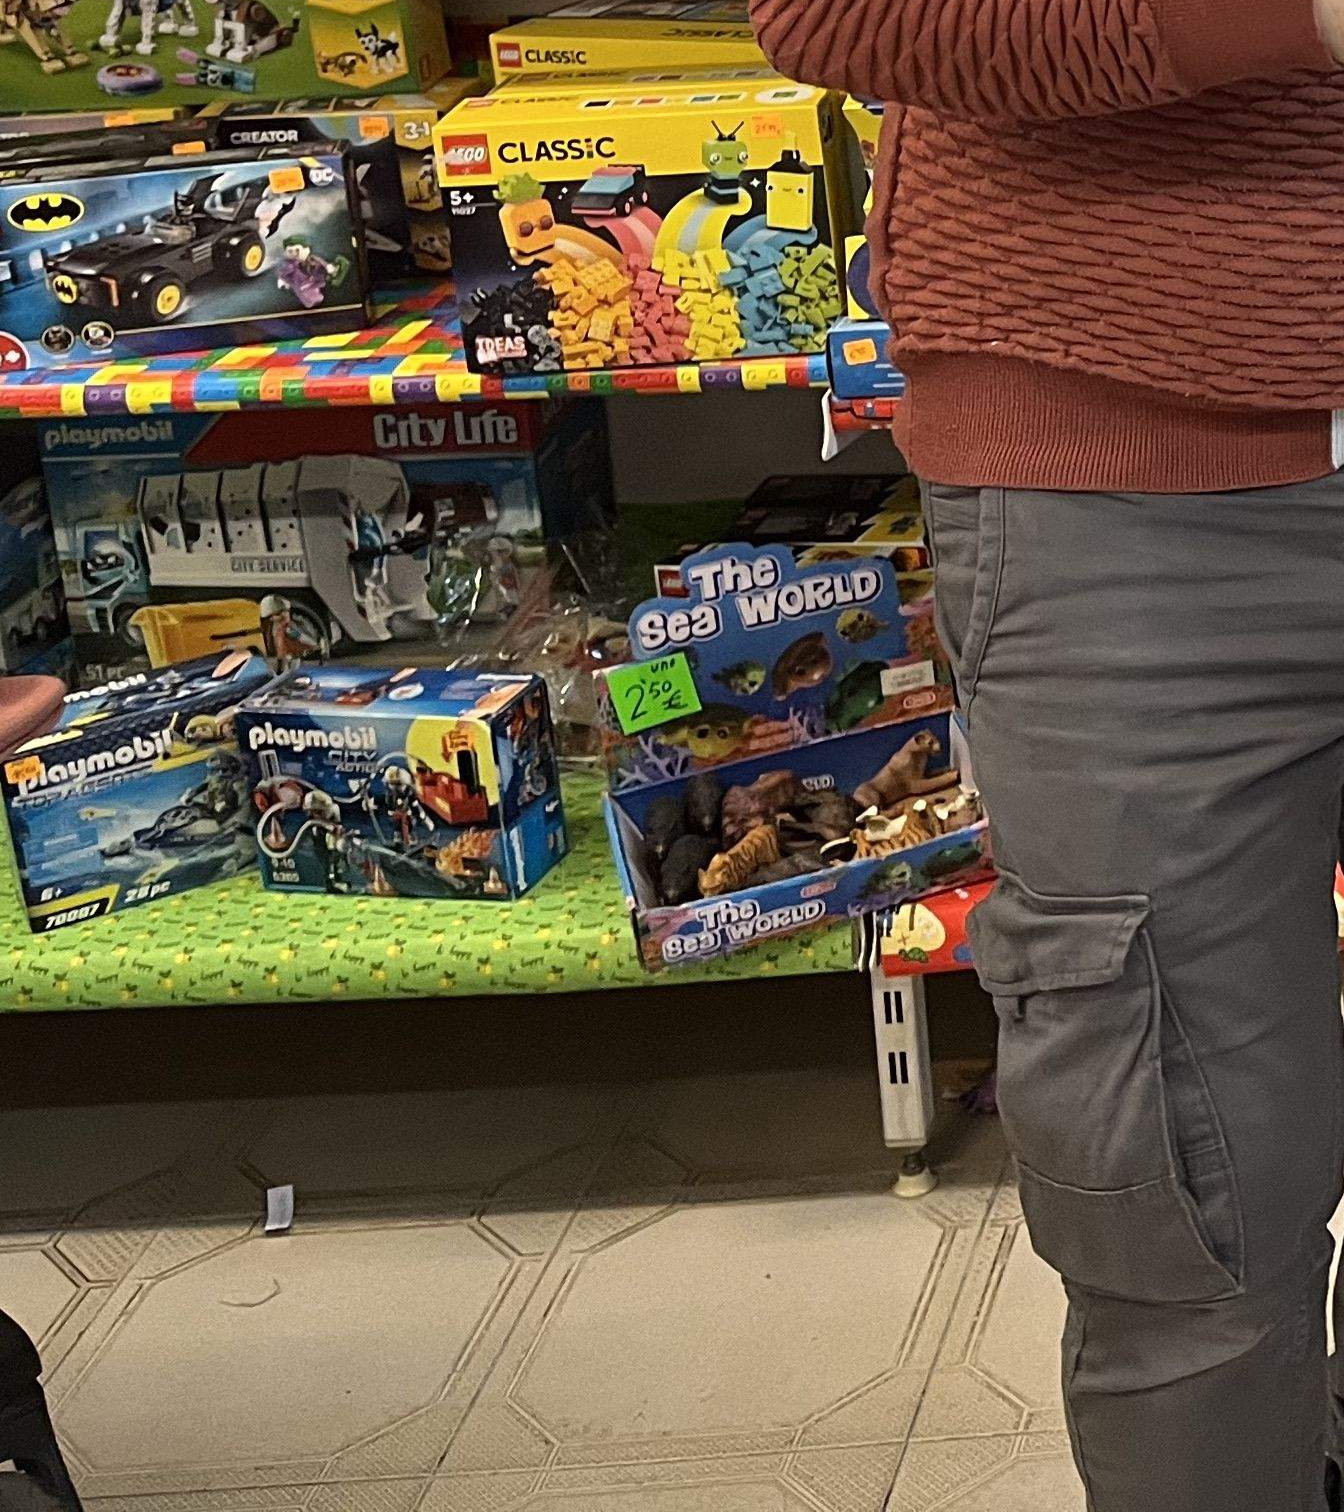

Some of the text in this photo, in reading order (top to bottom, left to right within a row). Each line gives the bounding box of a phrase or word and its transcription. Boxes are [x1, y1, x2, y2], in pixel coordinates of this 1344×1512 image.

[229, 128, 299, 145] CREATOR
[450, 189, 475, 206] 5+
[475, 336, 527, 354] IDEAS
[44, 420, 174, 451] playmobil
[372, 409, 519, 448] City Life
[691, 555, 782, 602] The
[637, 568, 884, 652] Sea WORLD
[624, 677, 674, 723] 2'50
[249, 721, 378, 752] playmobil
[18, 727, 174, 796] playmobil
[664, 898, 824, 961] Sea WORLD
[698, 900, 760, 936] The
